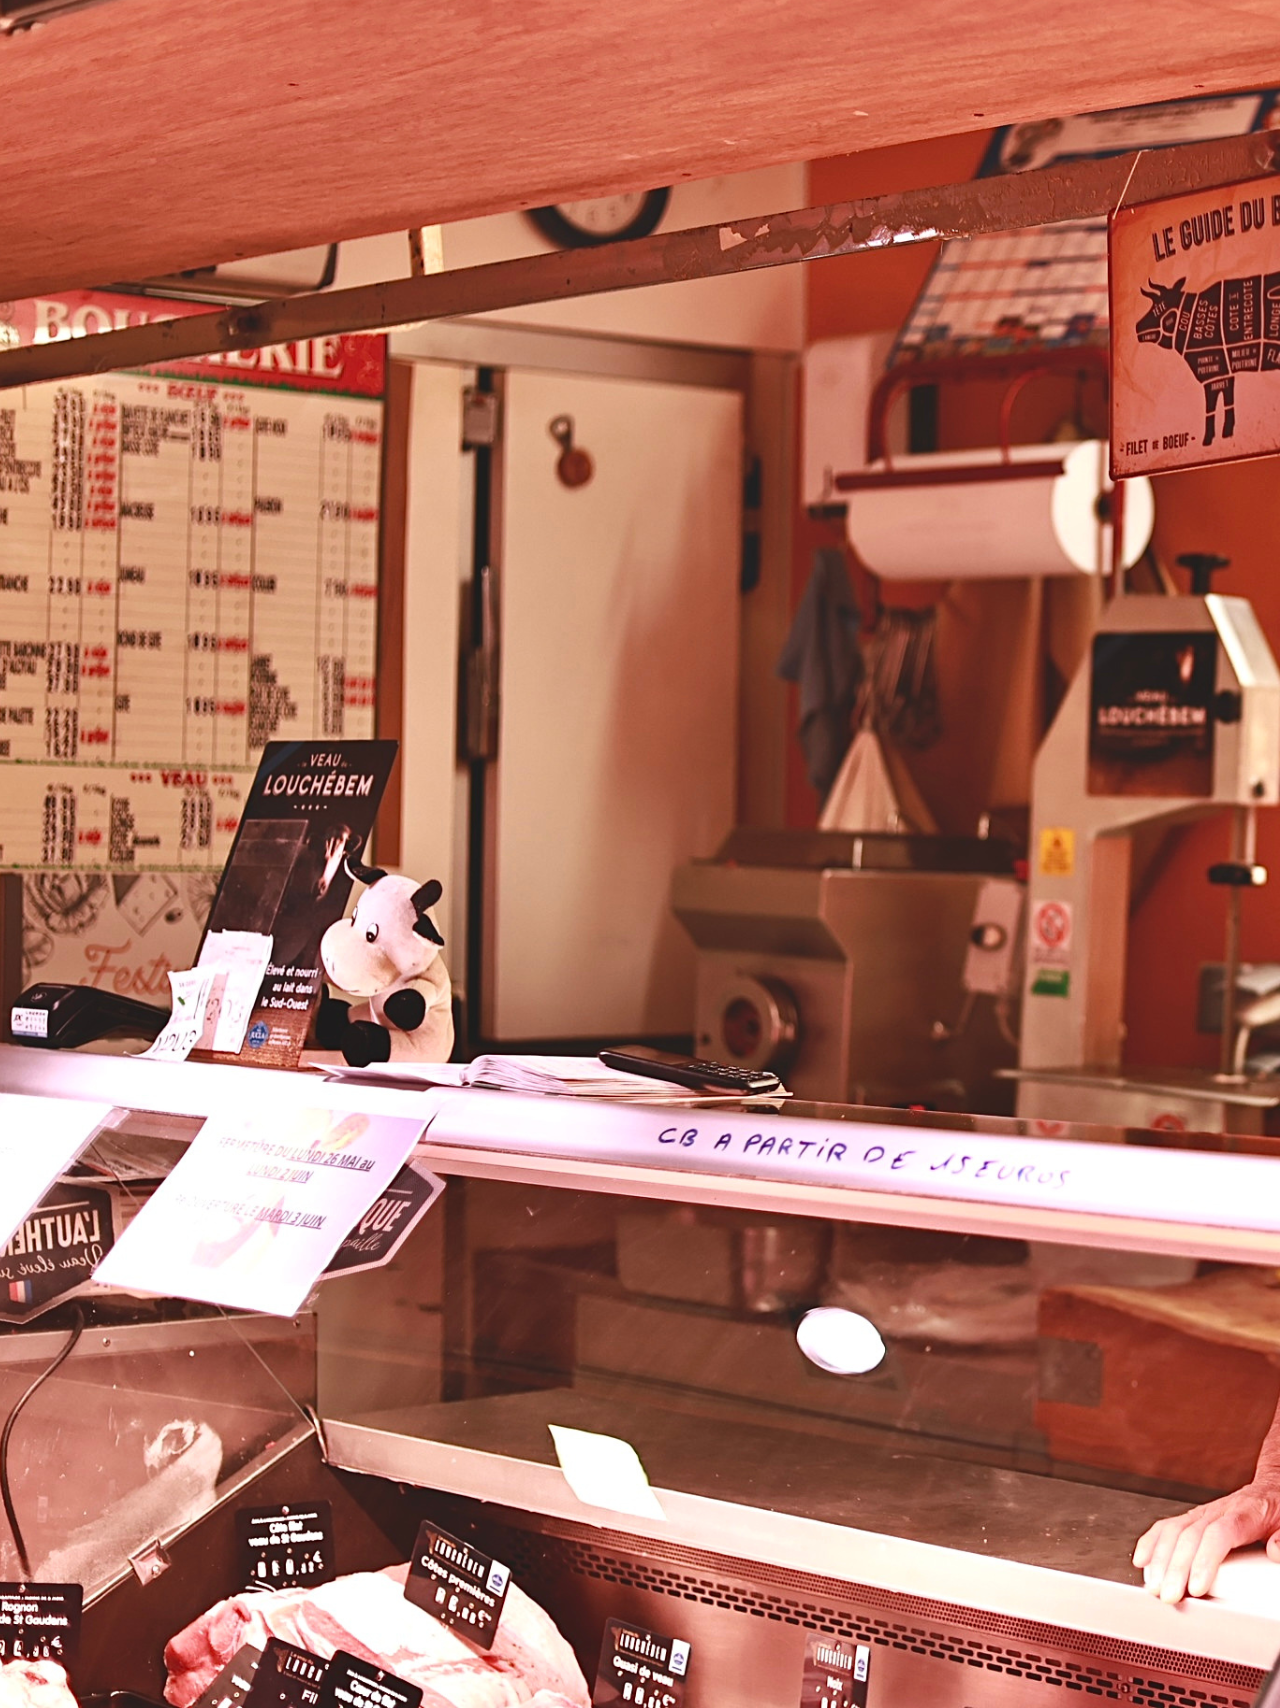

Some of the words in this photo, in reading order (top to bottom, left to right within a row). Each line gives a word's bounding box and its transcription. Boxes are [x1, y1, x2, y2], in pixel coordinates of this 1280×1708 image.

[1152, 227, 1176, 262] LE
[1180, 205, 1235, 251] GUIDE
[1240, 197, 1265, 233] DU
[1178, 311, 1191, 332] COU
[1193, 300, 1208, 340] BASSES
[1269, 302, 1280, 337] LONGE
[1126, 438, 1148, 456] FILET
[1163, 432, 1190, 451] BOEUF
[310, 753, 342, 768] VEAU
[161, 770, 208, 787] VEAU
[262, 770, 375, 797] LOUCHÉBEM
[286, 966, 294, 977] et
[295, 967, 319, 979] nourri
[272, 983, 281, 992] au
[283, 981, 294, 993] lait
[295, 983, 313, 994] dans
[261, 996, 268, 1007] le
[269, 996, 309, 1010] Sud-Ouest
[289, 1146, 326, 1165] LUNDI
[323, 1152, 338, 1165] 26
[339, 1154, 360, 1169] MAI
[359, 1158, 376, 1171] au
[658, 1127, 699, 1148] CB
[714, 1132, 733, 1151] A
[863, 1145, 917, 1171] DE
[246, 1163, 283, 1179] LUNDI
[285, 1168, 315, 1184] JUIN
[257, 1206, 294, 1225] MARDI
[296, 1215, 328, 1230] JUIN
[1, 1601, 39, 1614] Rognon
[13, 1615, 24, 1625] St
[25, 1613, 69, 1626] Gaudens
[613, 1655, 639, 1675] Quasi
[639, 1665, 652, 1679] de
[652, 1671, 675, 1688] veau
